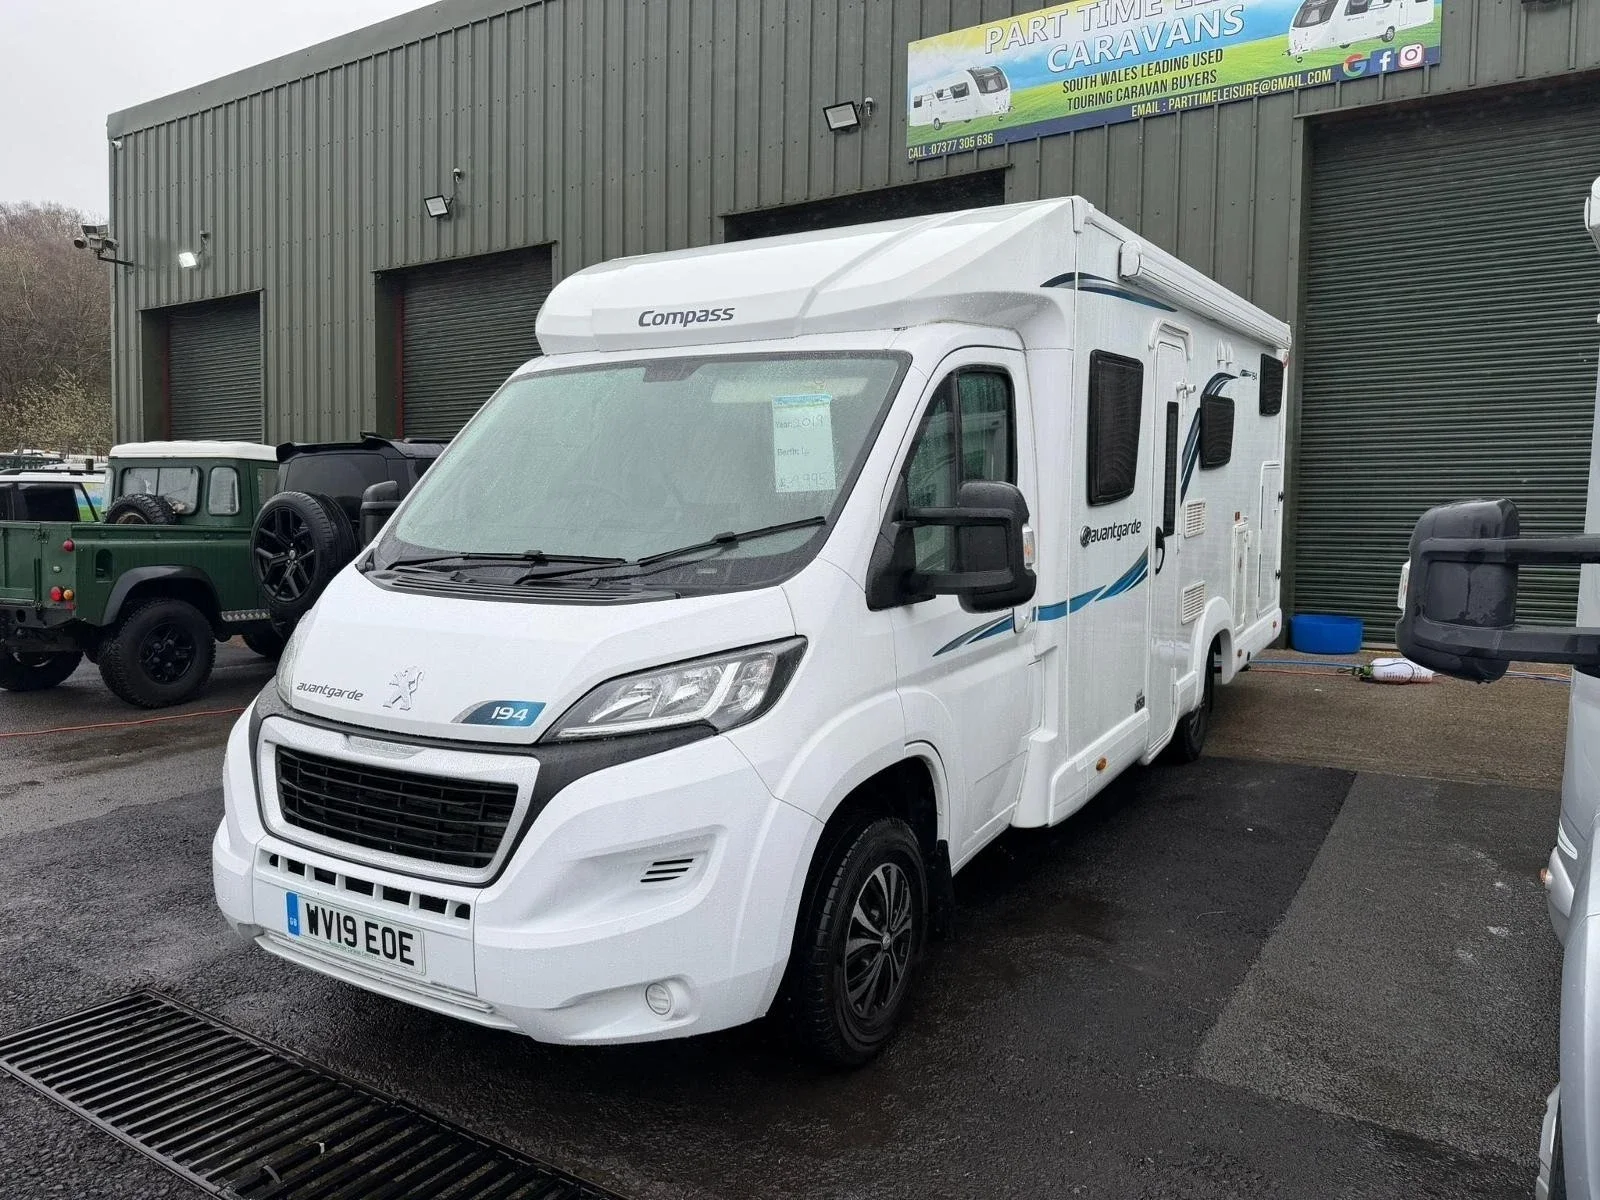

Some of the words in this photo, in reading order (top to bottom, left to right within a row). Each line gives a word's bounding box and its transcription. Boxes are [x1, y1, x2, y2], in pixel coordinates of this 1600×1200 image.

[985, 9, 1068, 54] PART
[1077, 0, 1162, 31] TIME
[1047, 4, 1245, 73] CARAVANS
[1063, 75, 1097, 93] SOUTH
[1101, 66, 1137, 85] WALES
[1141, 56, 1189, 78] LEADING
[1193, 48, 1223, 67] USED
[1067, 90, 1113, 111] TOURING
[1116, 79, 1168, 101] CARAVAN
[1172, 69, 1217, 91] BUYERS
[1131, 101, 1160, 117] EMAIL
[1168, 69, 1331, 110] PARTTIMELEISURE@GMAIL.COM
[908, 145, 927, 159] CALL
[959, 136, 975, 149] 305
[977, 133, 993, 146] 636
[638, 308, 735, 327] Compass
[1090, 518, 1142, 543] avantgarde
[296, 681, 364, 702] avantgarde
[490, 705, 528, 721] 194
[306, 902, 357, 948] WV19
[364, 921, 414, 966] EOE
